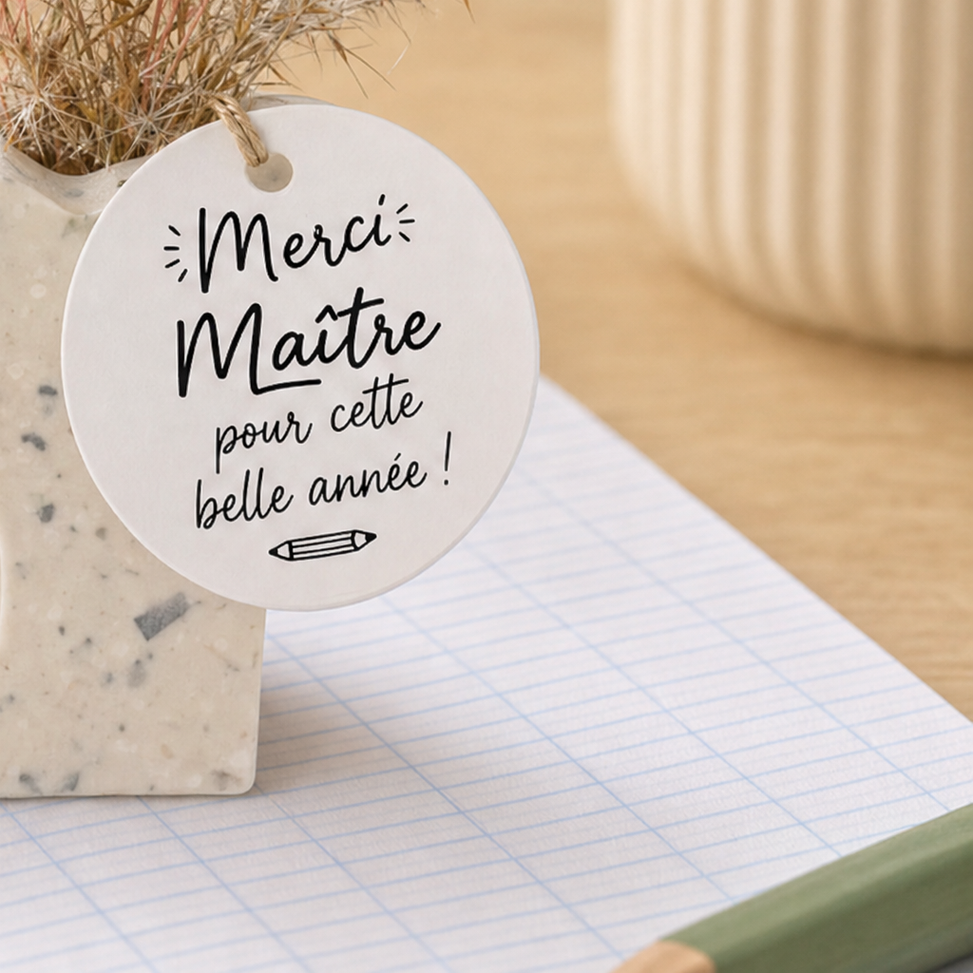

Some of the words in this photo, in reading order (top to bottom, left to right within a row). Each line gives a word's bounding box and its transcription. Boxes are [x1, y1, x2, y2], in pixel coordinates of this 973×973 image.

[198, 193, 392, 294] Merci
[176, 286, 442, 398] Maître
[215, 411, 313, 475] pour
[330, 372, 424, 433] cette
[195, 467, 294, 530] belle
[308, 452, 428, 506] année
[443, 430, 453, 487] !
